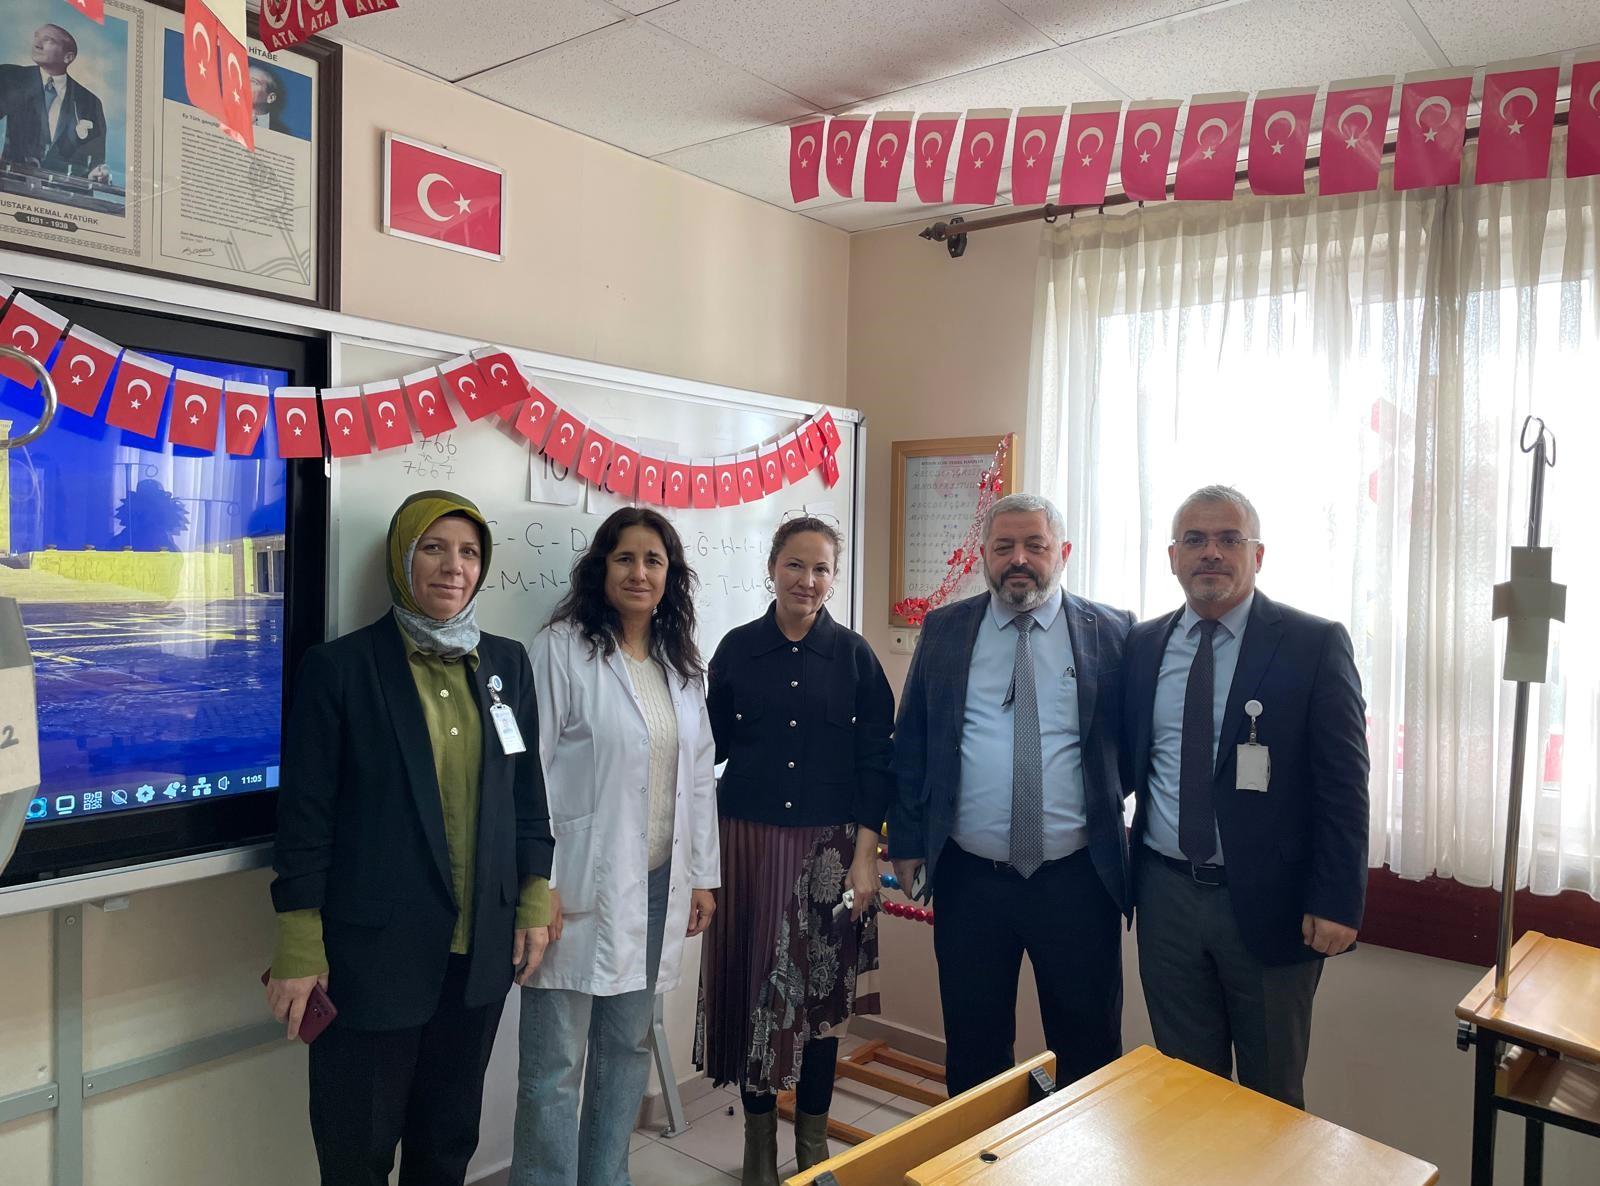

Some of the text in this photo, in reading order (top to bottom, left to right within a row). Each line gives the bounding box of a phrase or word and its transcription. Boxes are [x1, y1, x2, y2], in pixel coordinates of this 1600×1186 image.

[311, 11, 331, 31] ATA
[272, 30, 299, 48] ATA
[0, 201, 32, 212] USTAFA
[34, 206, 61, 218] KEMAL
[180, 774, 263, 793] 2 11:05
